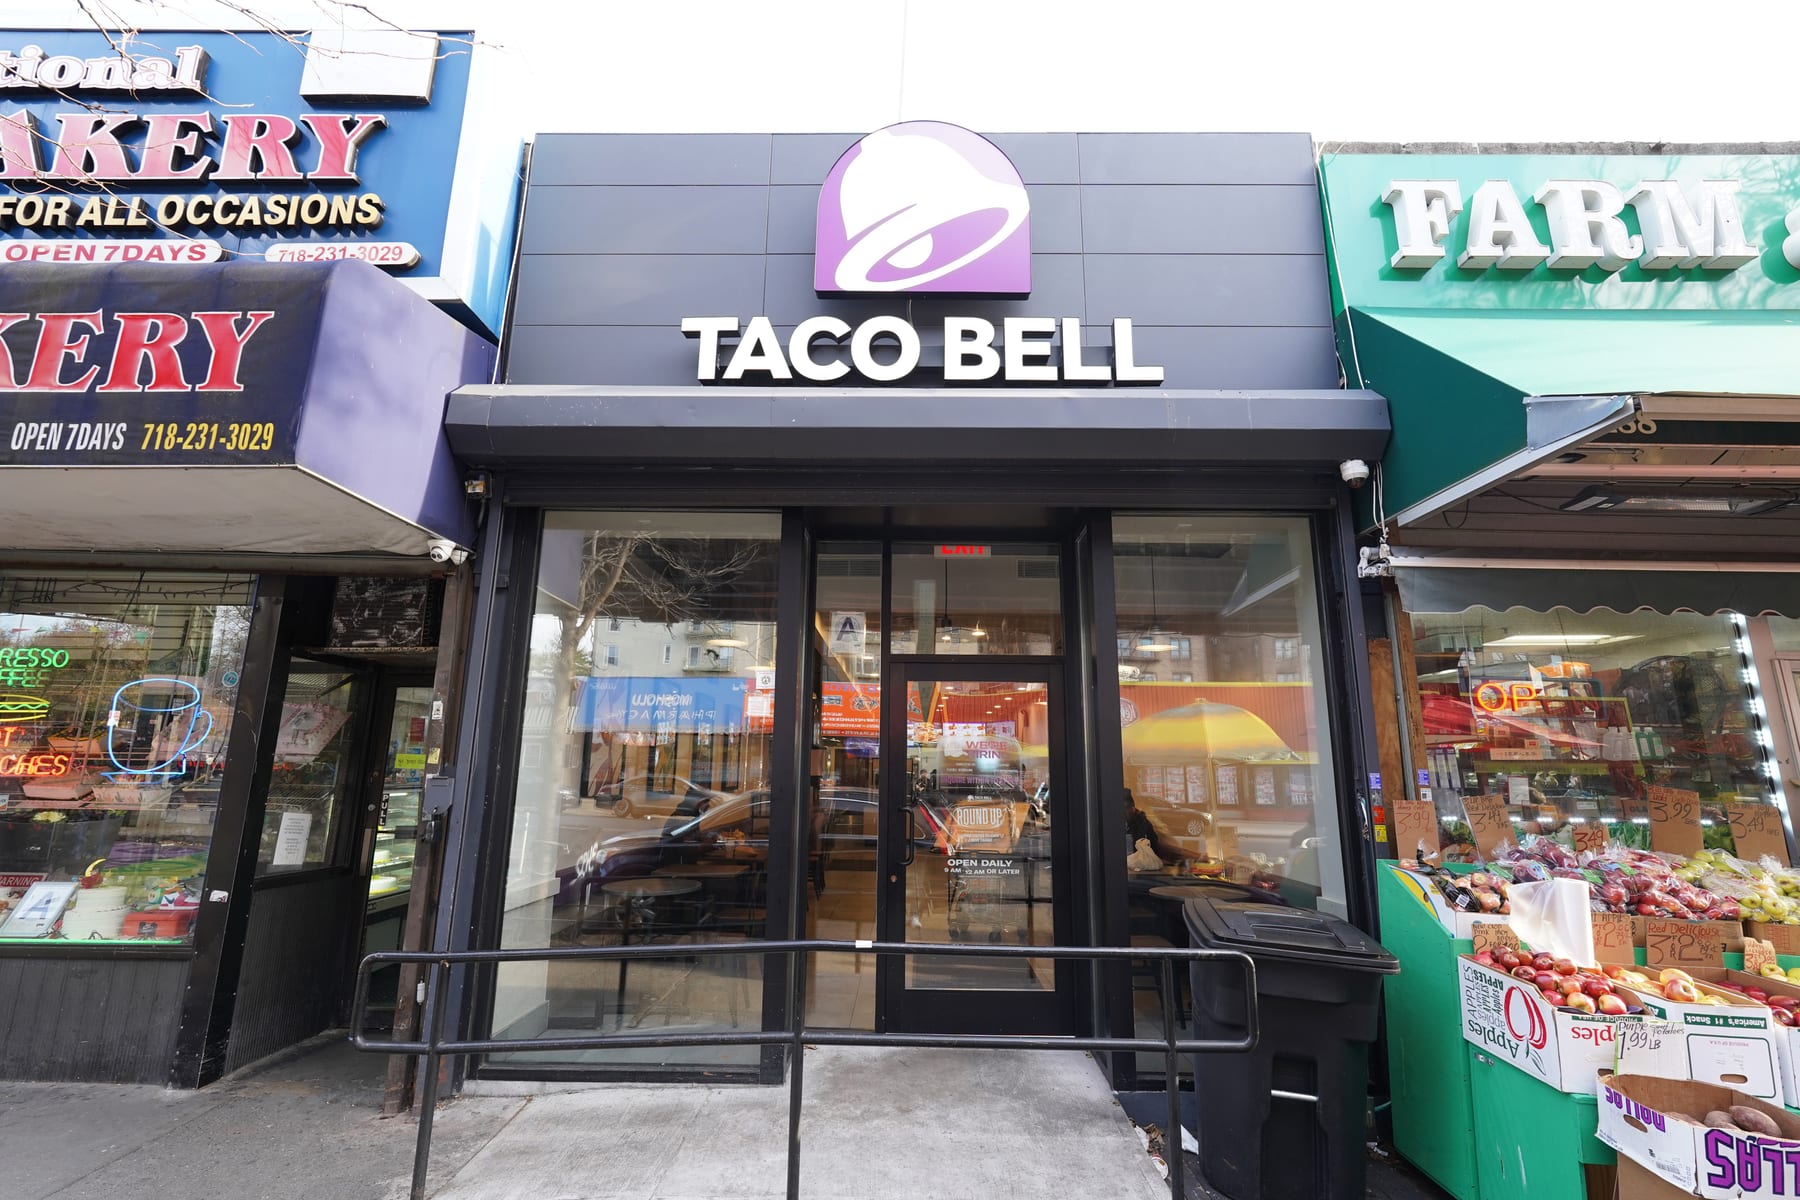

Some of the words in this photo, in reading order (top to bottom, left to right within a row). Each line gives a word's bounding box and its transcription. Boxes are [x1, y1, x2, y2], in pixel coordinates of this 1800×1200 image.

[0, 195, 71, 226] FOR
[76, 195, 149, 226] ALL
[157, 193, 382, 226] OCCASIONS
[1382, 179, 1759, 270] FARM
[5, 244, 97, 262] OPEN
[278, 245, 404, 263] 718-231-3029
[681, 315, 921, 383] TACO
[944, 316, 1165, 384] BELL
[10, 423, 64, 451] OPEN
[141, 423, 275, 452] 718-231-3029
[837, 616, 857, 641] A
[379, 794, 390, 826] PULL
[956, 807, 990, 826] ROUND
[1649, 800, 1692, 823] 3.99
[1728, 811, 1765, 839] 3.49
[1574, 829, 1604, 853] 3.49
[947, 858, 978, 867] OPEN
[981, 859, 1013, 867] DAILY
[0, 876, 40, 888] ARNING
[1648, 922, 1667, 933] Red
[1473, 968, 1504, 991] APPLES
[1463, 964, 1480, 1020] APPLES
[1477, 1010, 1506, 1031] apples
[1685, 1014, 1711, 1025] Snack
[1728, 1016, 1766, 1028] America's
[1468, 1019, 1520, 1058] Apples
[1570, 1025, 1616, 1047] ples
[1617, 1031, 1648, 1060] 1.99
[1648, 1038, 1662, 1050] LB
